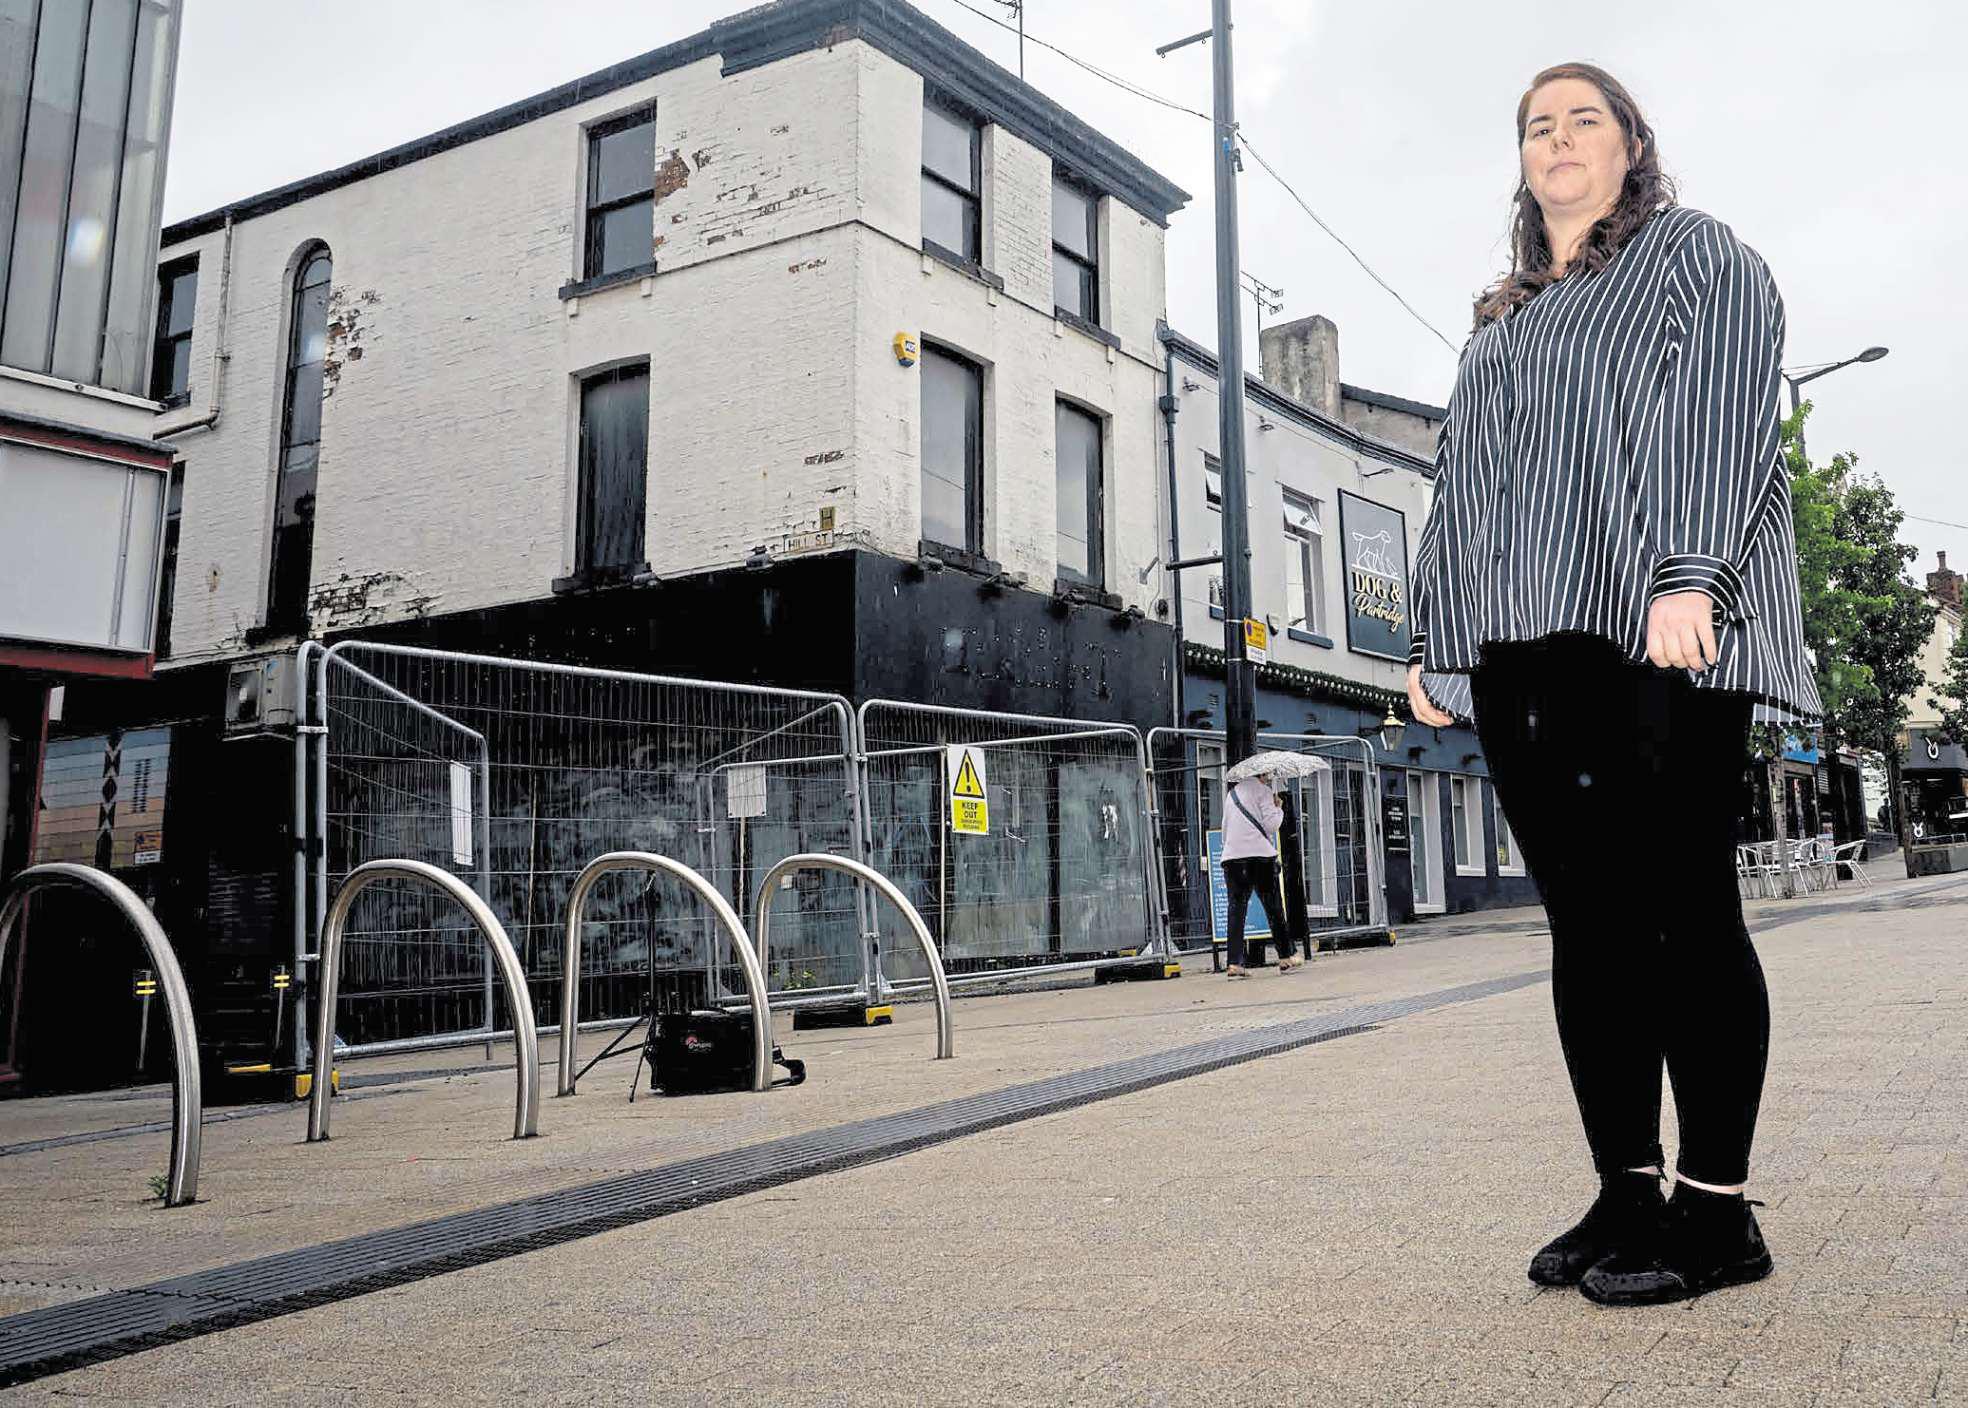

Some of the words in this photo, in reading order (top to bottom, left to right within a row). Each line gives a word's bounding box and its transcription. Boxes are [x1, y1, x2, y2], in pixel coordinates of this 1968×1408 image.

[821, 508, 833, 529] H
[1352, 572, 1387, 599] DOG
[1389, 582, 1402, 604] &
[1353, 593, 1405, 632] Partridge
[961, 802, 978, 810] KEEP
[964, 810, 977, 819] OUT
